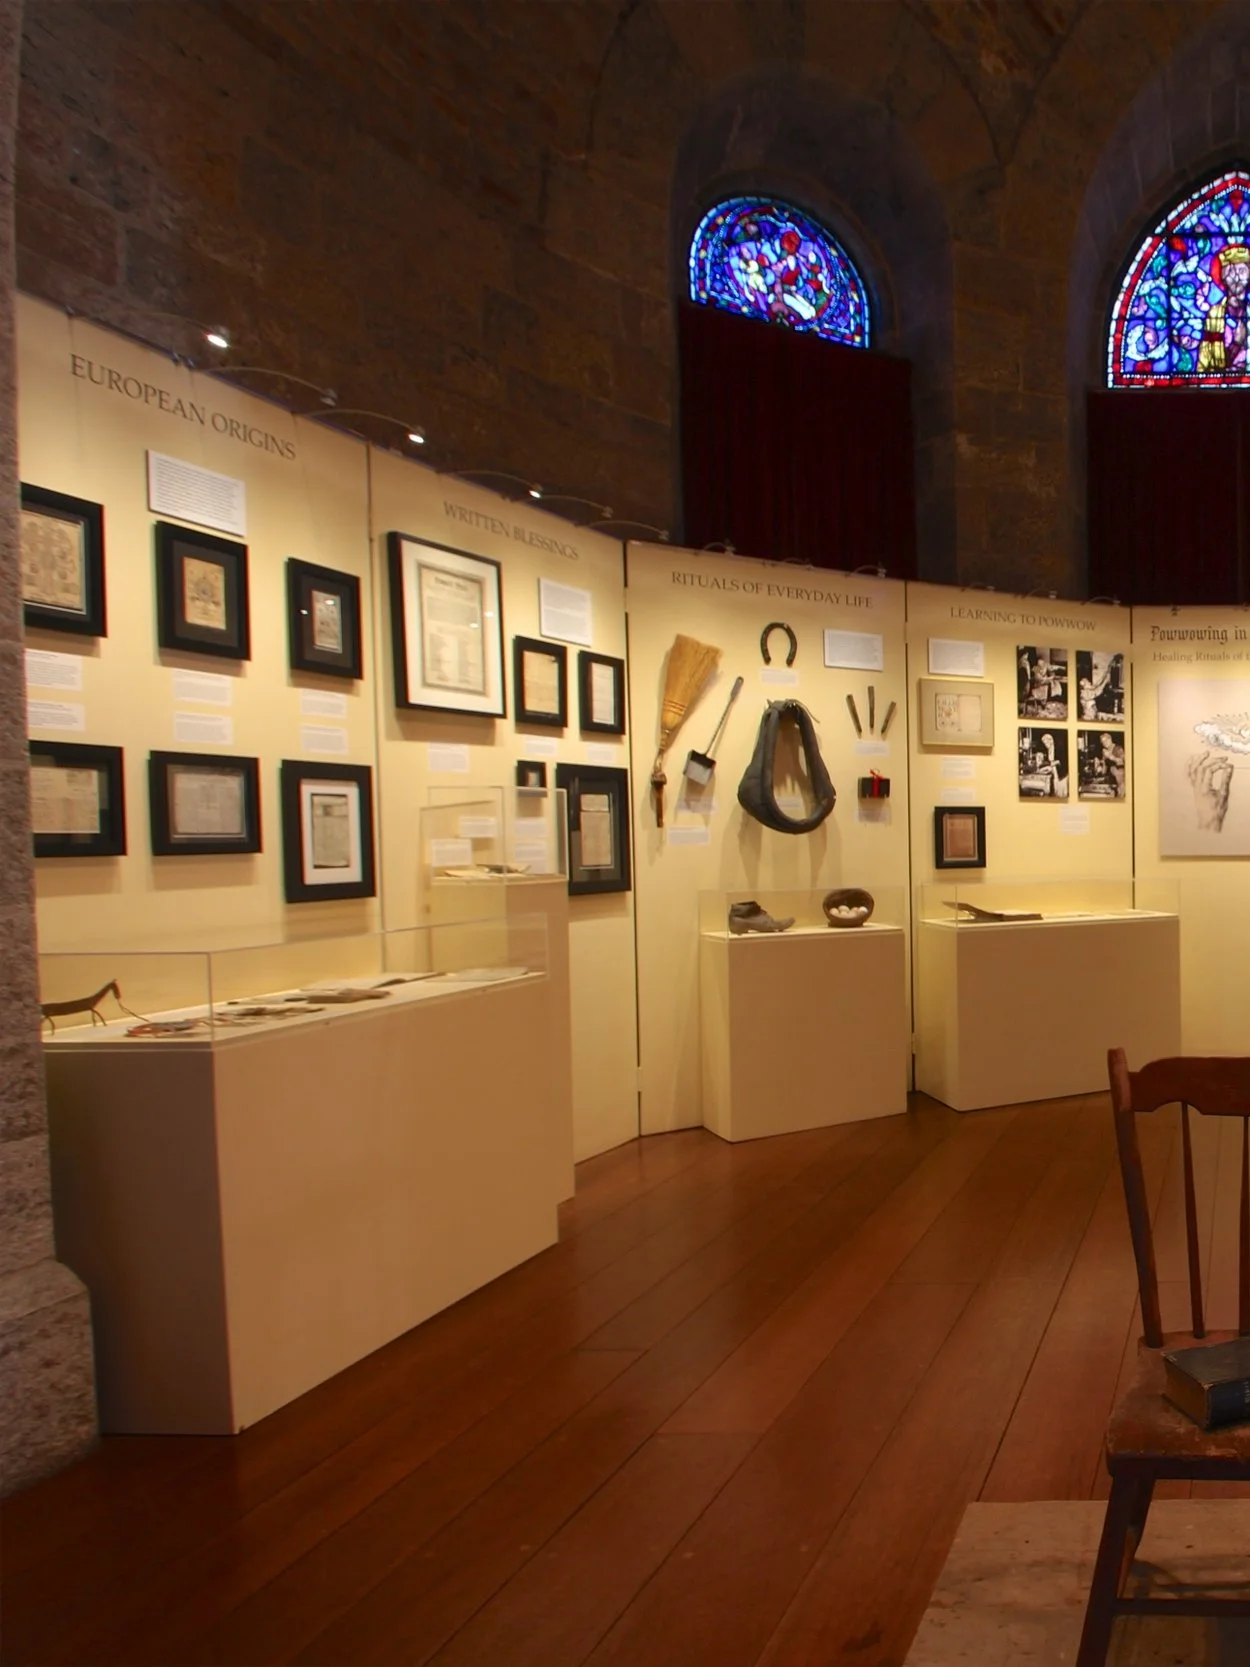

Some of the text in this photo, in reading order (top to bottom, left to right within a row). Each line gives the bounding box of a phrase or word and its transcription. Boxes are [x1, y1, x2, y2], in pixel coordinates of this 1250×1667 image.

[70, 354, 296, 460] EUROPEAN ORIGINS
[443, 501, 578, 559] WRITTEN BLESSINGS
[671, 571, 873, 608] RITUALS OF EVERYDAY LIFE
[950, 606, 1096, 631] LEARNING TO POWWOW
[1150, 625, 1228, 645] Powwowing
[1234, 625, 1248, 640] in
[1153, 651, 1193, 663] Healing
[1196, 651, 1230, 662] Rituals
[1233, 651, 1244, 662] of
